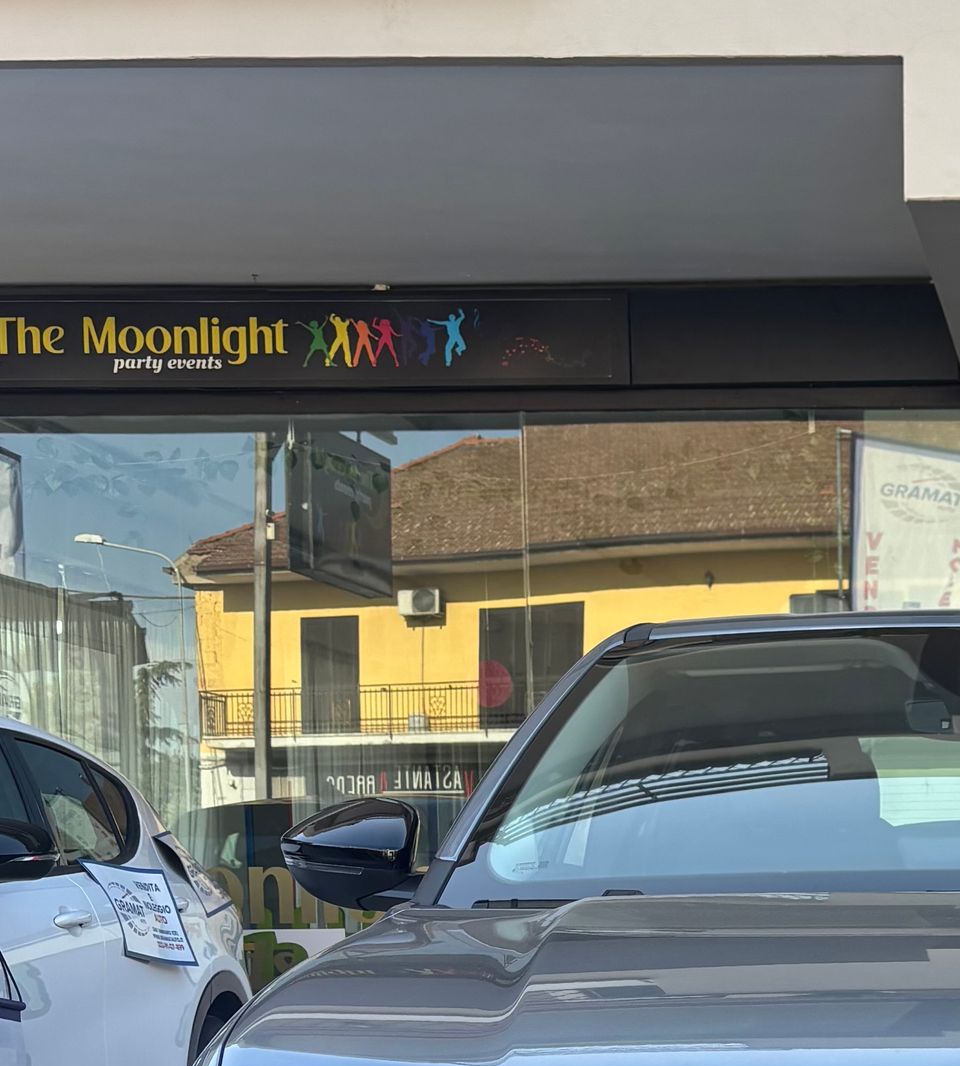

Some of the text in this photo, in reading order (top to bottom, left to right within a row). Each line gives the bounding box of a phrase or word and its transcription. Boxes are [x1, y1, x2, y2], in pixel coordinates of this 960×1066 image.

[0, 316, 288, 365] The Moonlight
[113, 356, 223, 374] party events
[114, 898, 145, 917] GRAMAT
